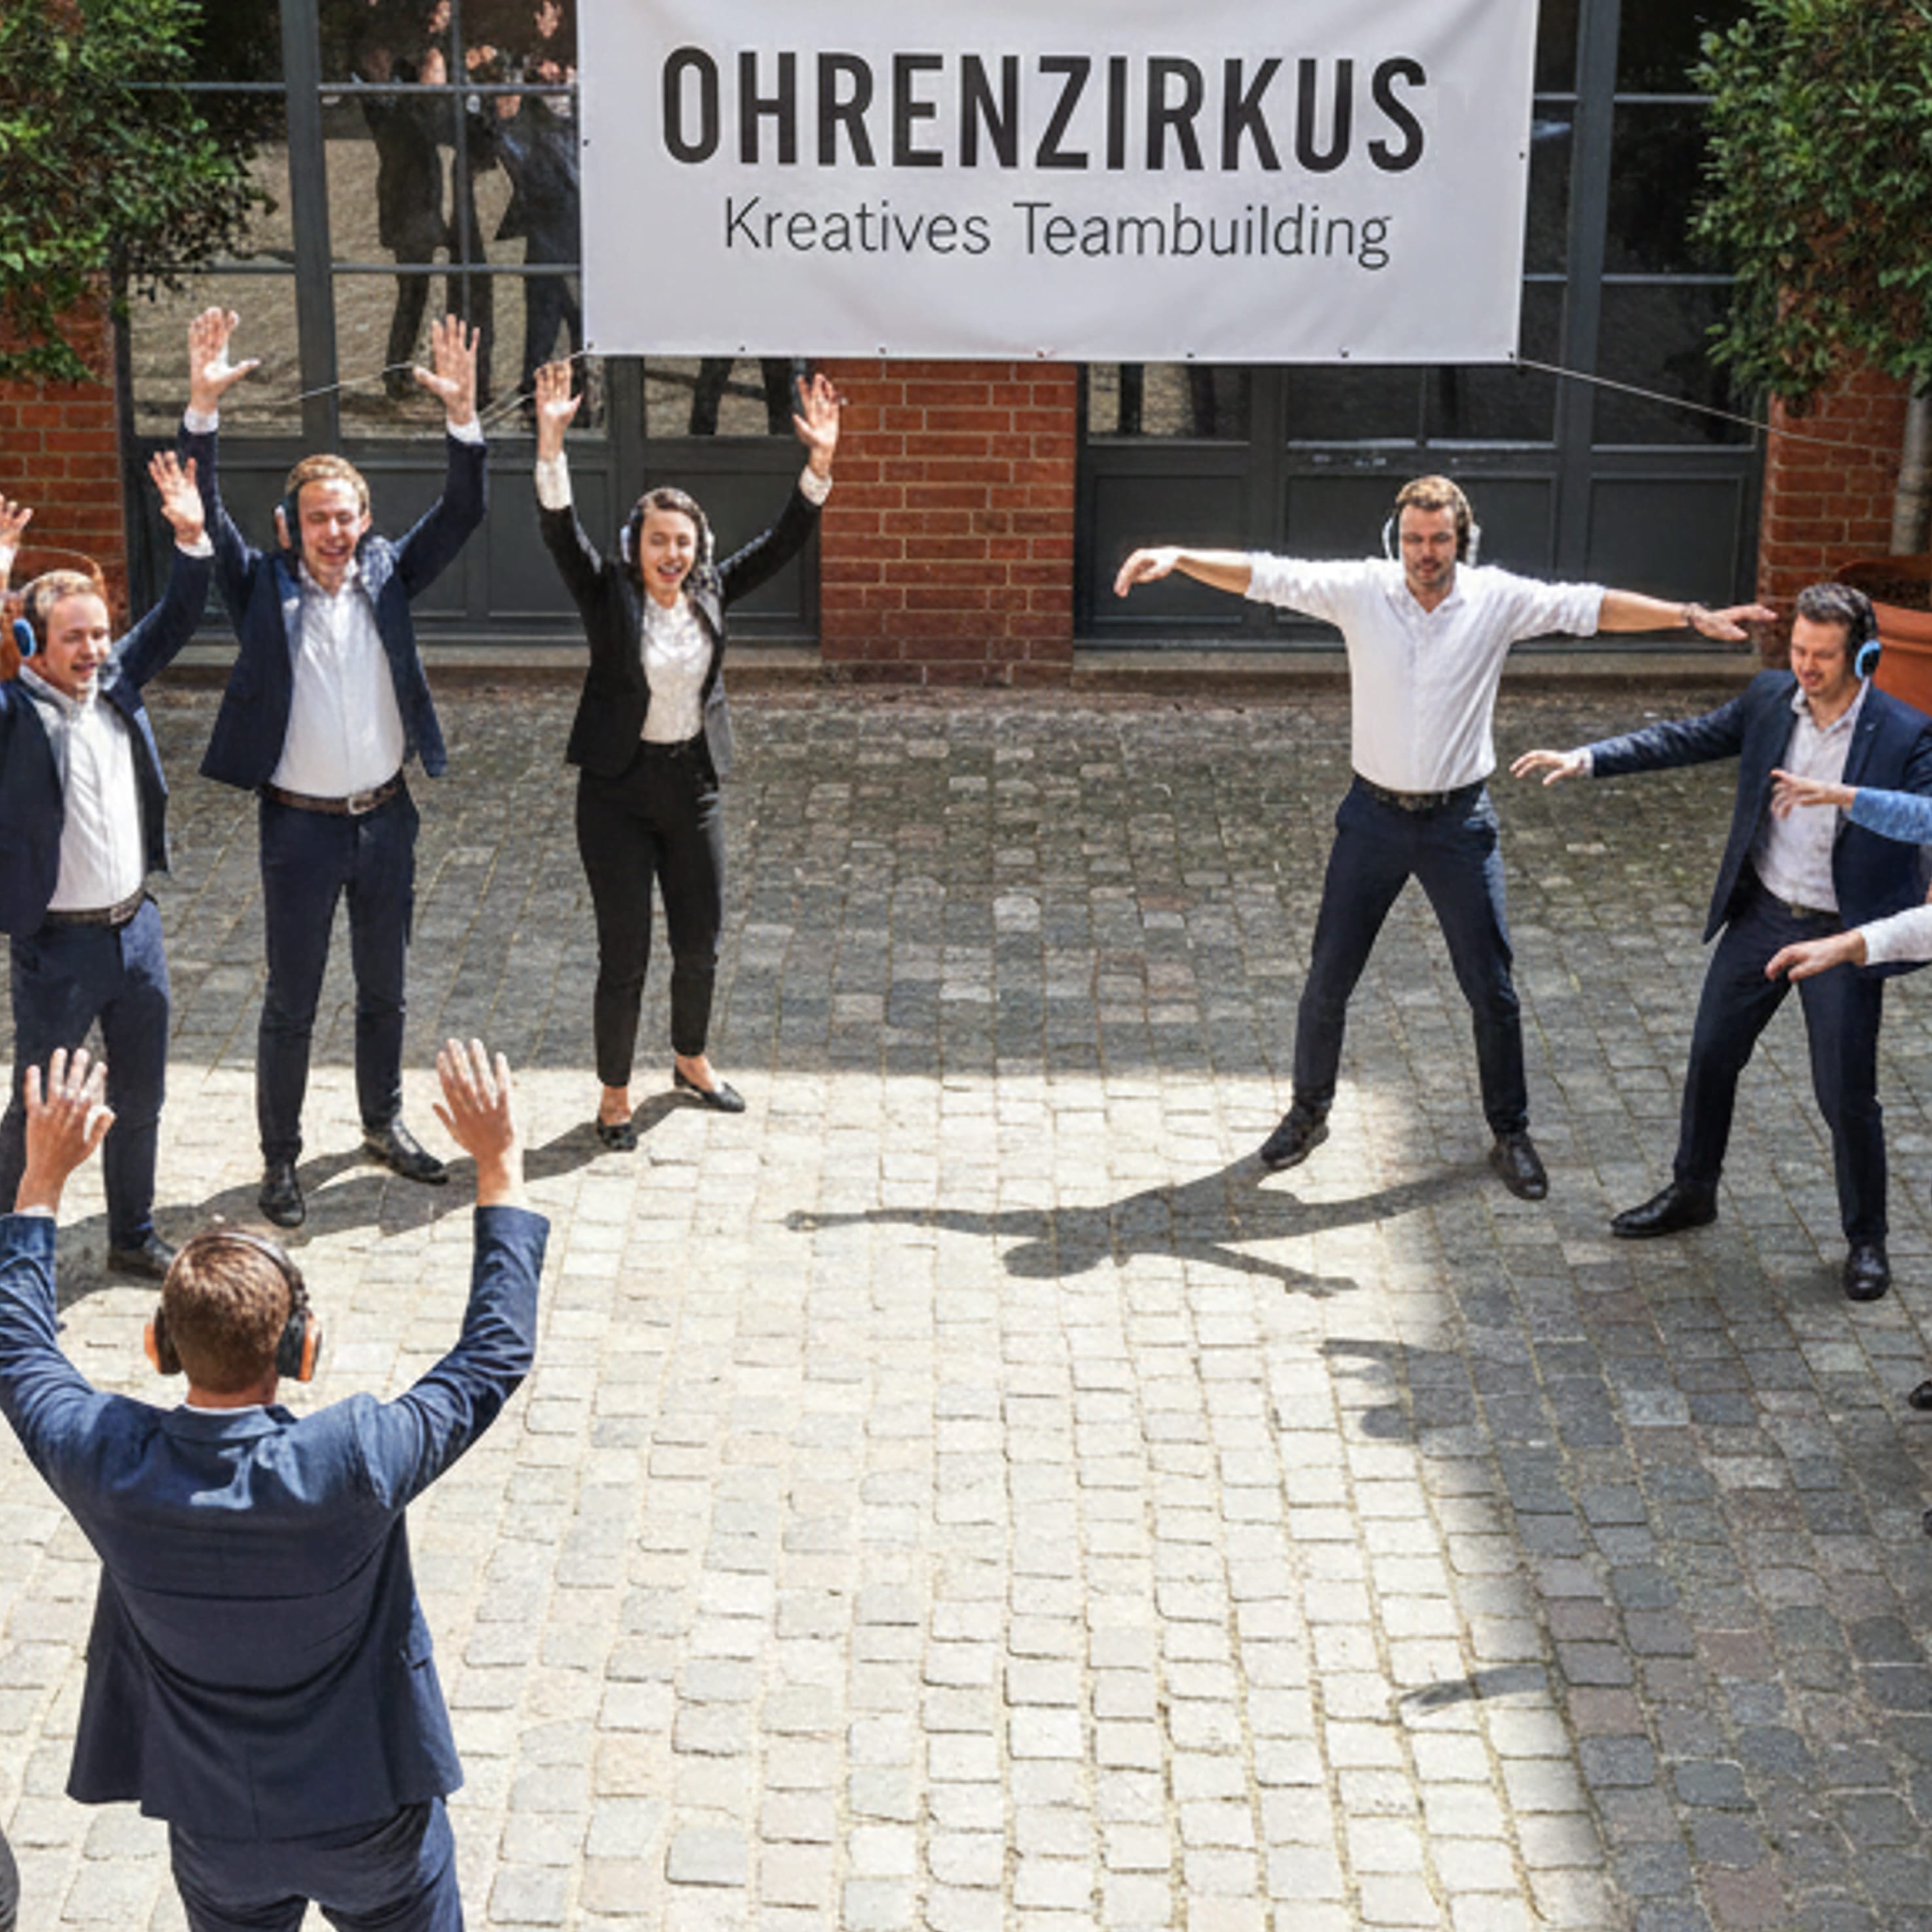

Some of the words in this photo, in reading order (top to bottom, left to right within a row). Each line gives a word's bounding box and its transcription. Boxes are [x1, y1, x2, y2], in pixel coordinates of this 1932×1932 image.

[662, 46, 1427, 173] OHRENZIRKUS
[725, 196, 991, 255] Kreatives
[1012, 202, 1391, 271] Teambuilding
